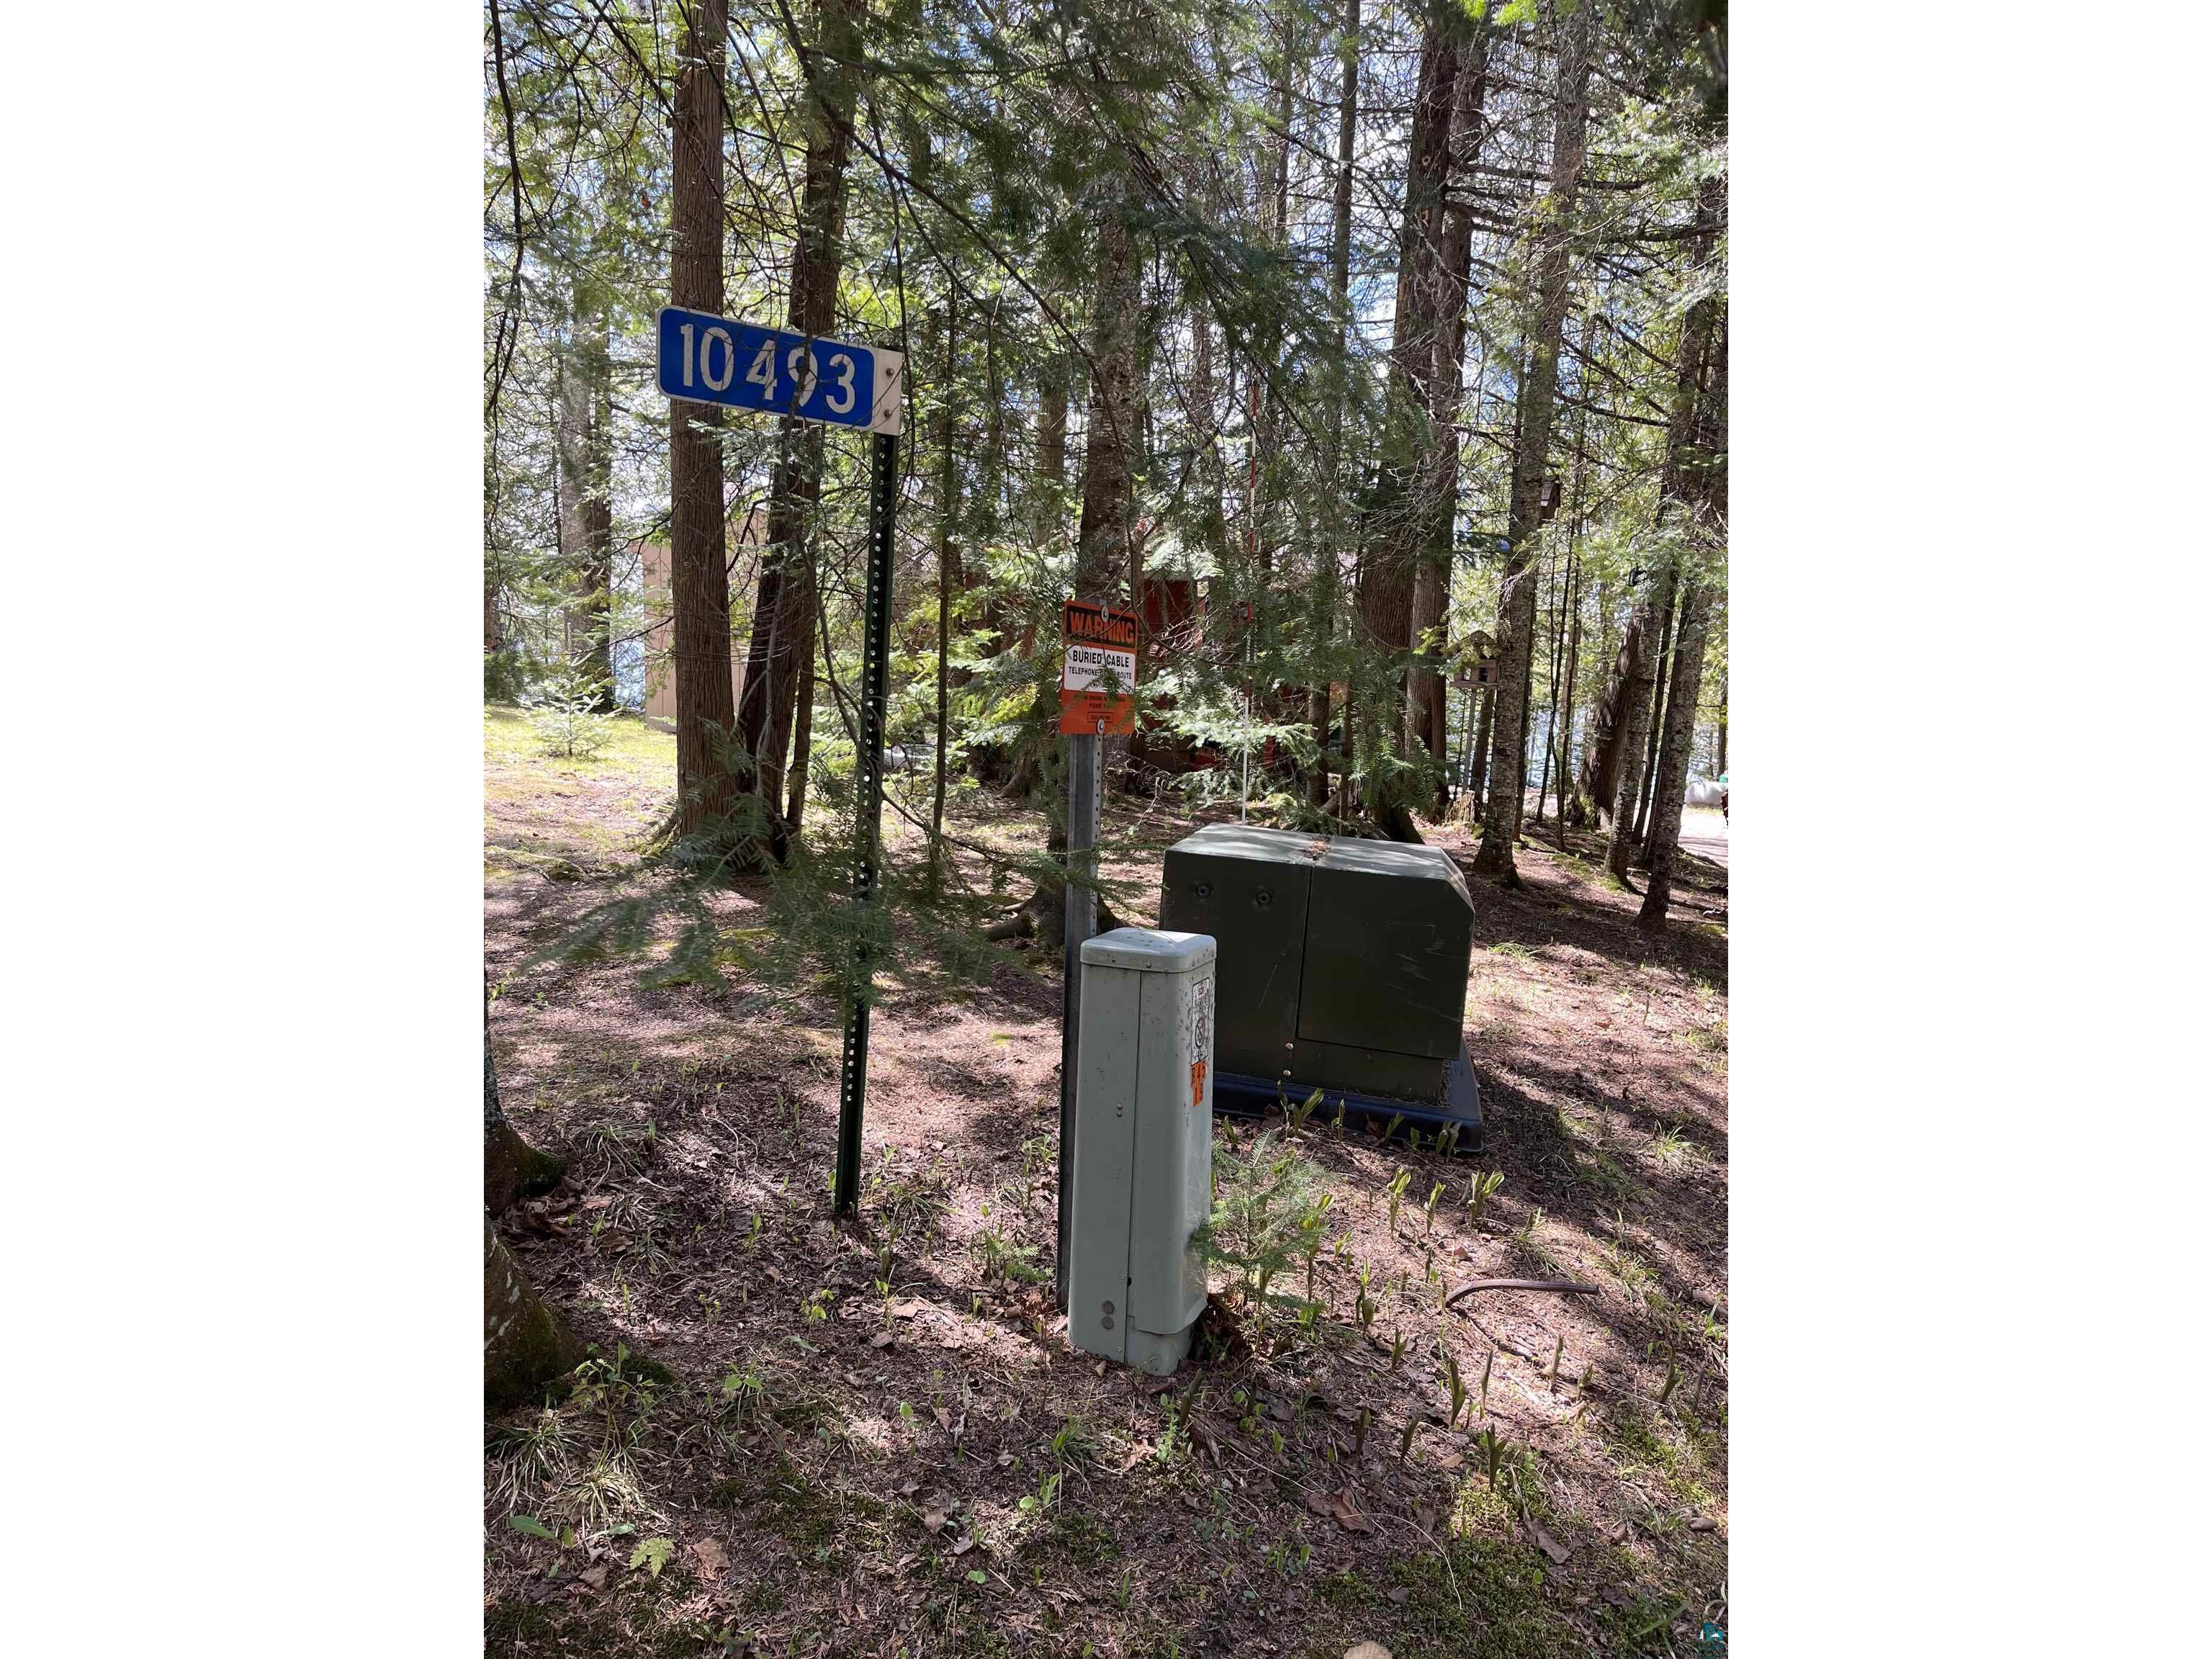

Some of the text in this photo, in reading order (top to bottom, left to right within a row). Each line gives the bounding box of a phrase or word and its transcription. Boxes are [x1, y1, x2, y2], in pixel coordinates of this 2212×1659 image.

[680, 323, 856, 414] 10493
[1070, 611, 1134, 644] WARNING
[1073, 649, 1129, 667] BURIED CABLE
[1069, 667, 1097, 677] TELEPHONE
[1117, 671, 1132, 680] ROUTE
